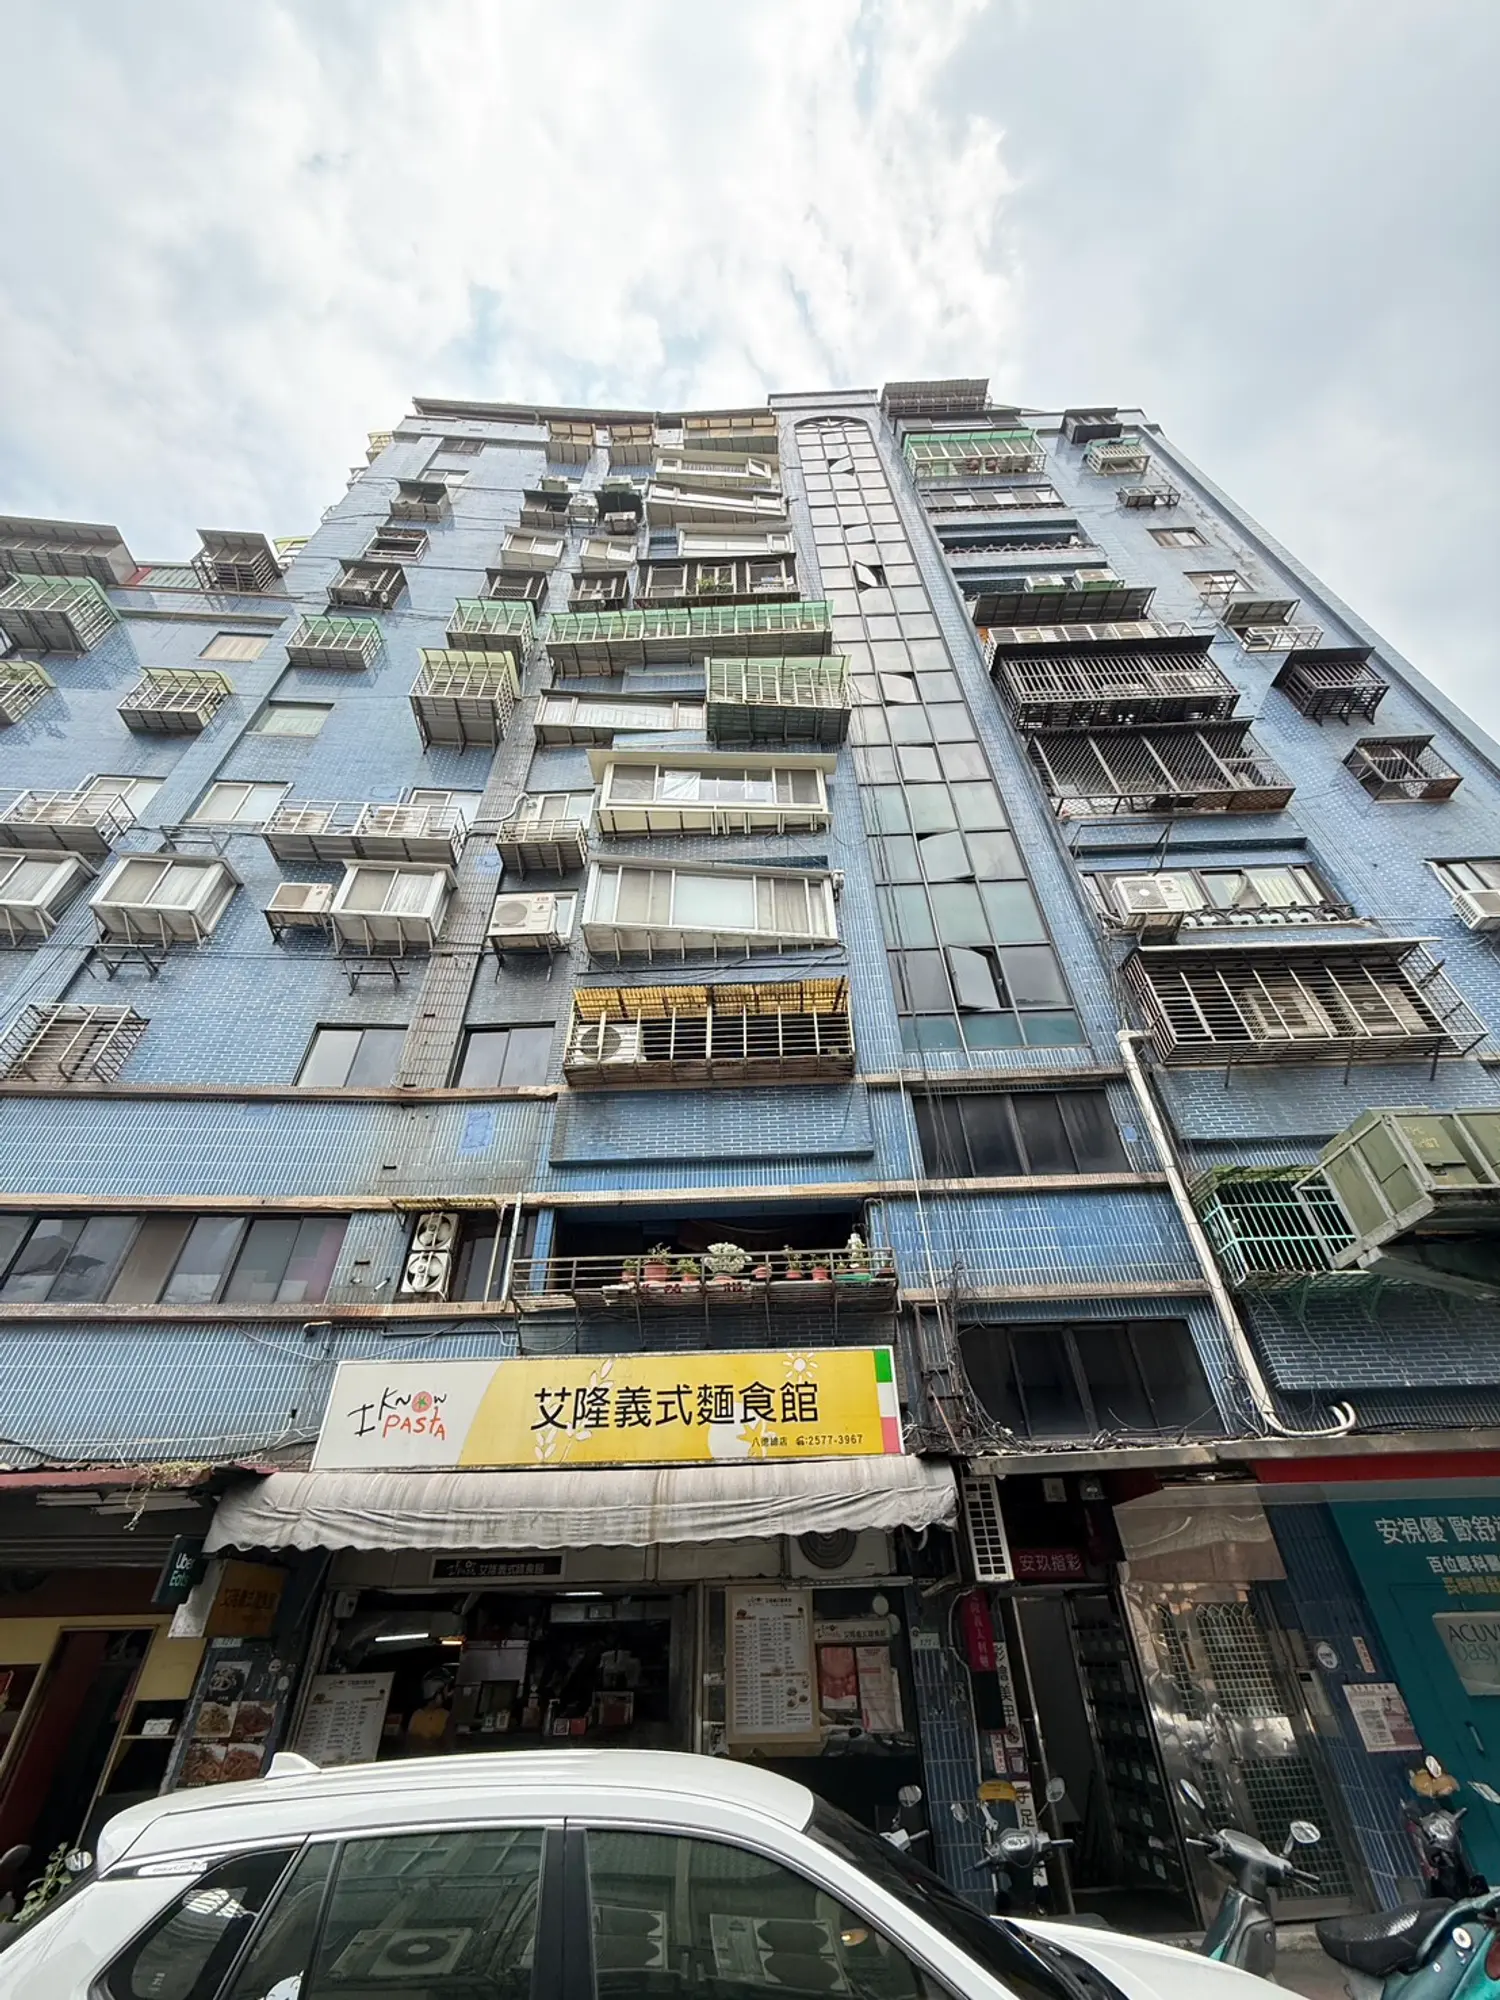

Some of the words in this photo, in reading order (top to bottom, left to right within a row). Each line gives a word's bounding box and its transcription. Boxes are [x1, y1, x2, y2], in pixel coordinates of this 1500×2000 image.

[530, 1381, 819, 1431] 艾隆義式麵食館
[1447, 1515, 1500, 1542] 歐舒
[1426, 1555, 1500, 1573] 百位眼科醫
[1447, 1623, 1500, 1643] ACUV
